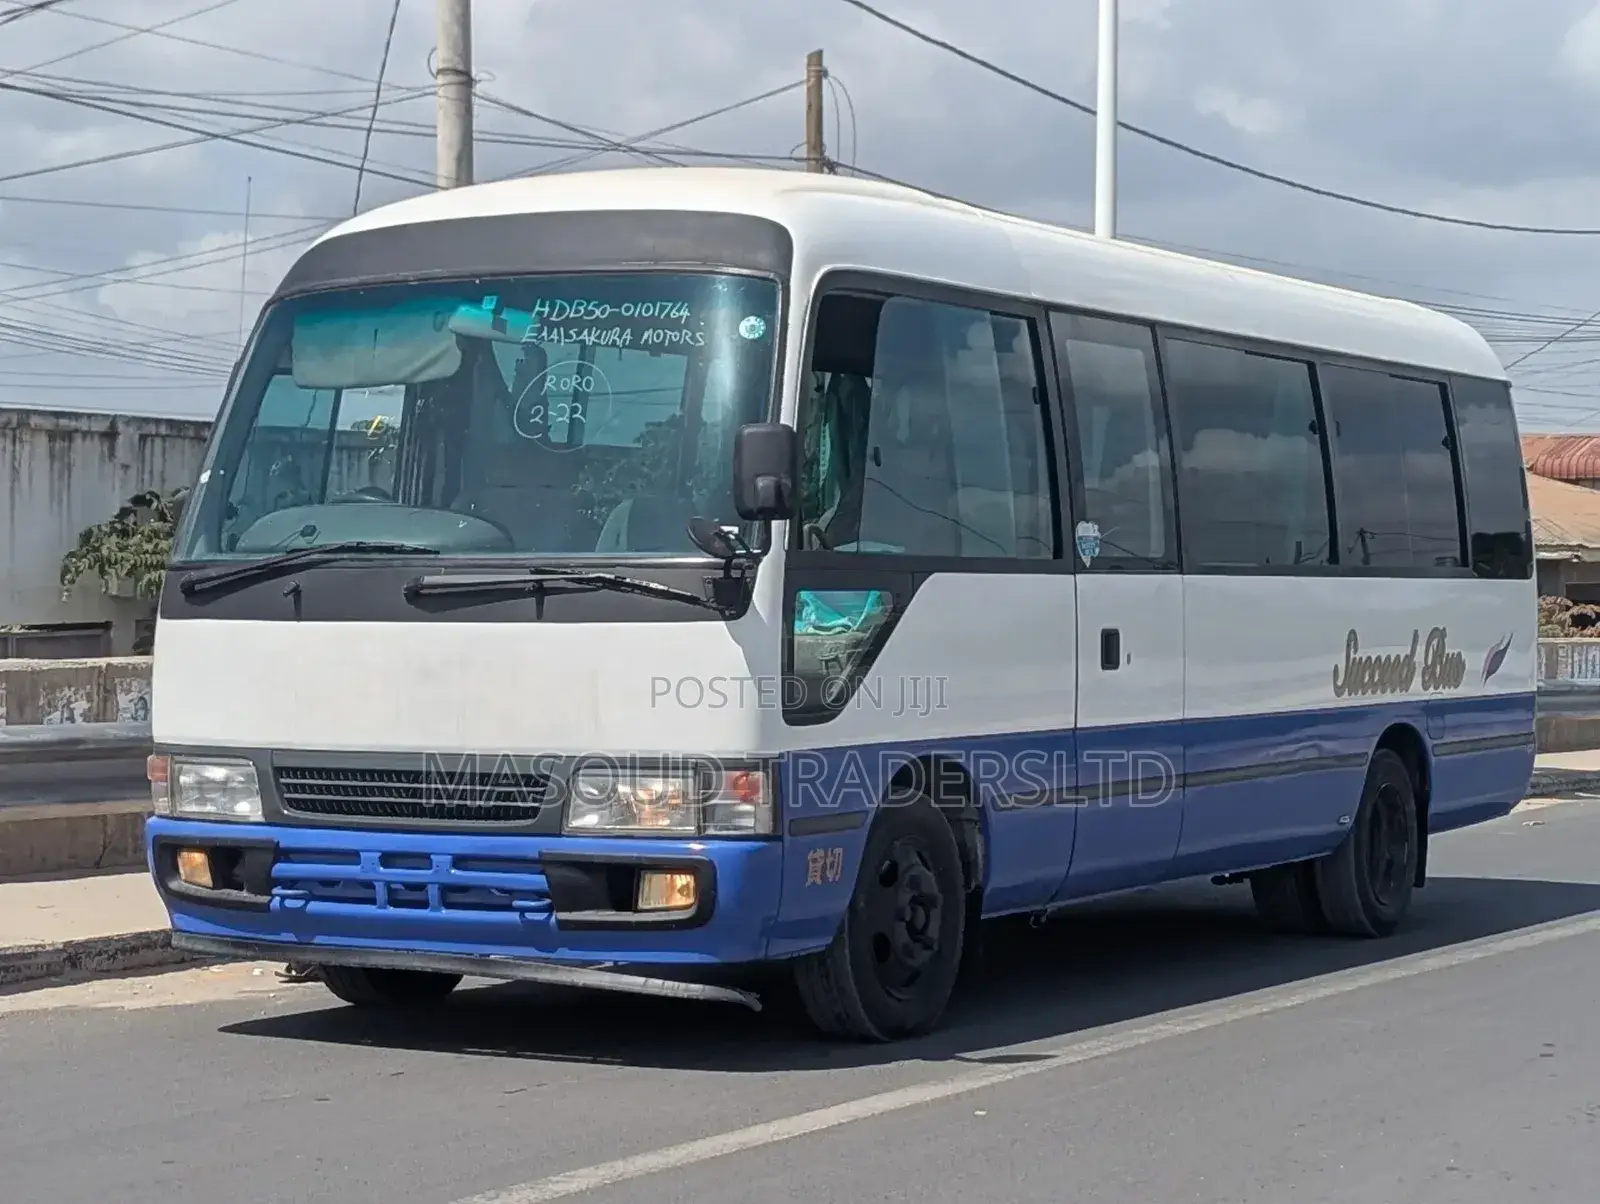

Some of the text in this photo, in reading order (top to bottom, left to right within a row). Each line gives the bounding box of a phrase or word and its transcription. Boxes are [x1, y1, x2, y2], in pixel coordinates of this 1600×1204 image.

[640, 328, 705, 347] MOTORS
[541, 374, 595, 396] RORO
[529, 403, 586, 424] 2-22
